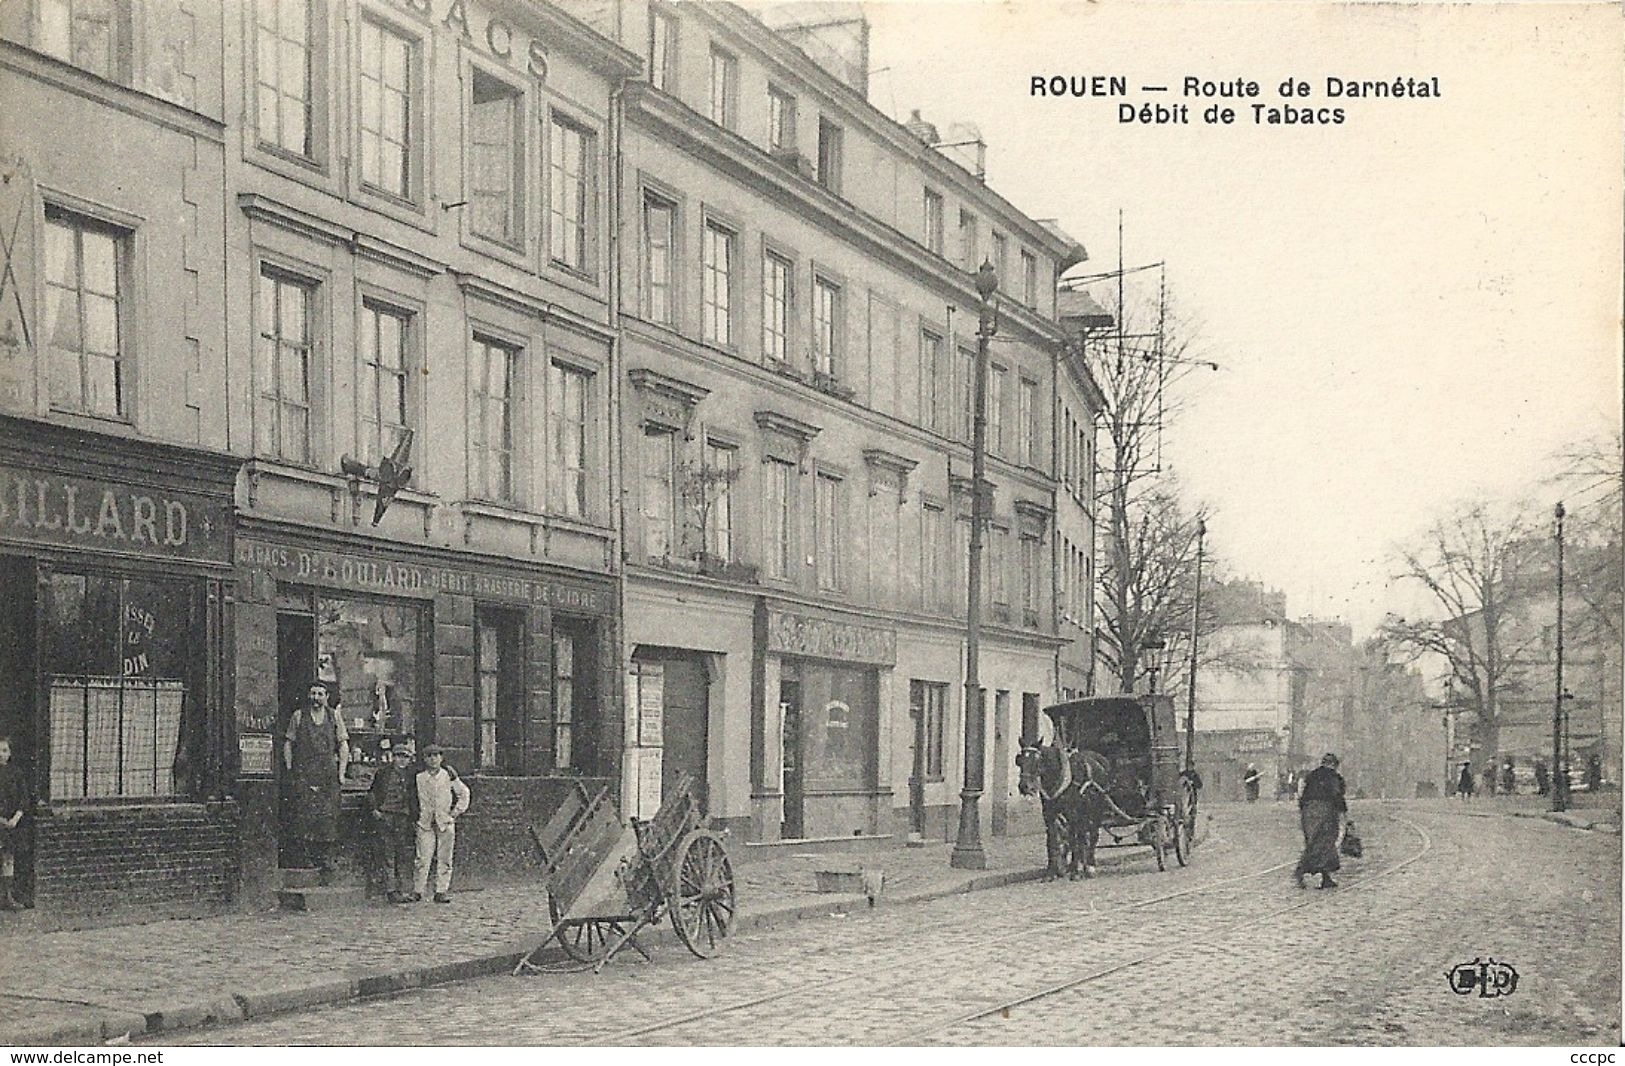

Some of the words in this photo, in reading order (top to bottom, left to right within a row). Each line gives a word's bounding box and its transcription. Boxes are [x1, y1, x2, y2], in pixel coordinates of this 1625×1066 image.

[0, 473, 187, 546] ILLARD
[535, 584, 550, 602] DE
[556, 584, 597, 608] CIDRE
